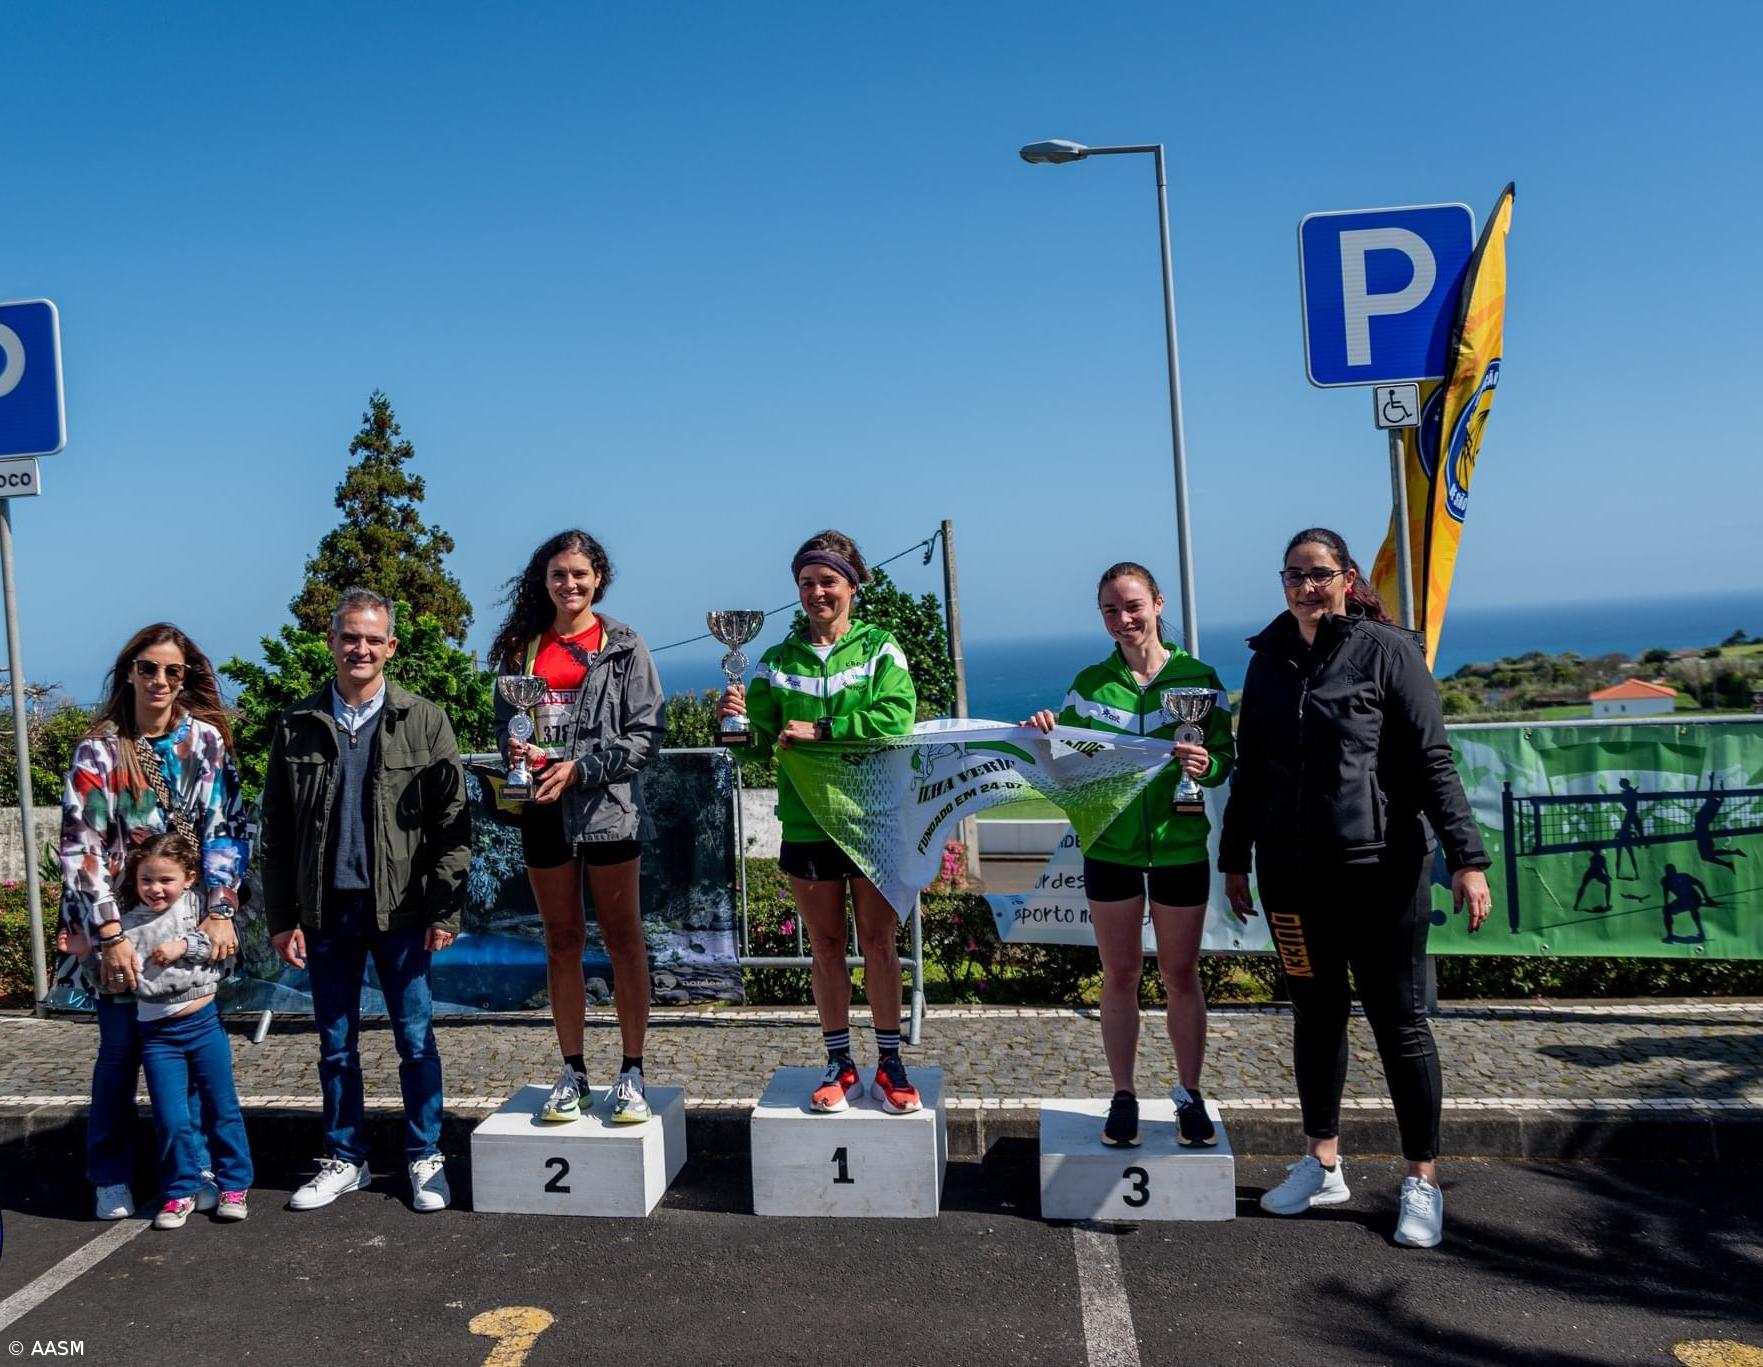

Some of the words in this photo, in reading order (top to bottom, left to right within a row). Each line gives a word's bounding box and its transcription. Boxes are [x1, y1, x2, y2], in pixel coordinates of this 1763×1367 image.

[1340, 227, 1437, 366] P
[917, 777, 954, 804] ILHA
[917, 803, 954, 856] FUNDADO
[954, 788, 977, 807] EM
[1270, 911, 1314, 977] QUEEN
[545, 1157, 571, 1193] 2
[831, 1147, 855, 1184] 1
[1122, 1166, 1150, 1208] 3
